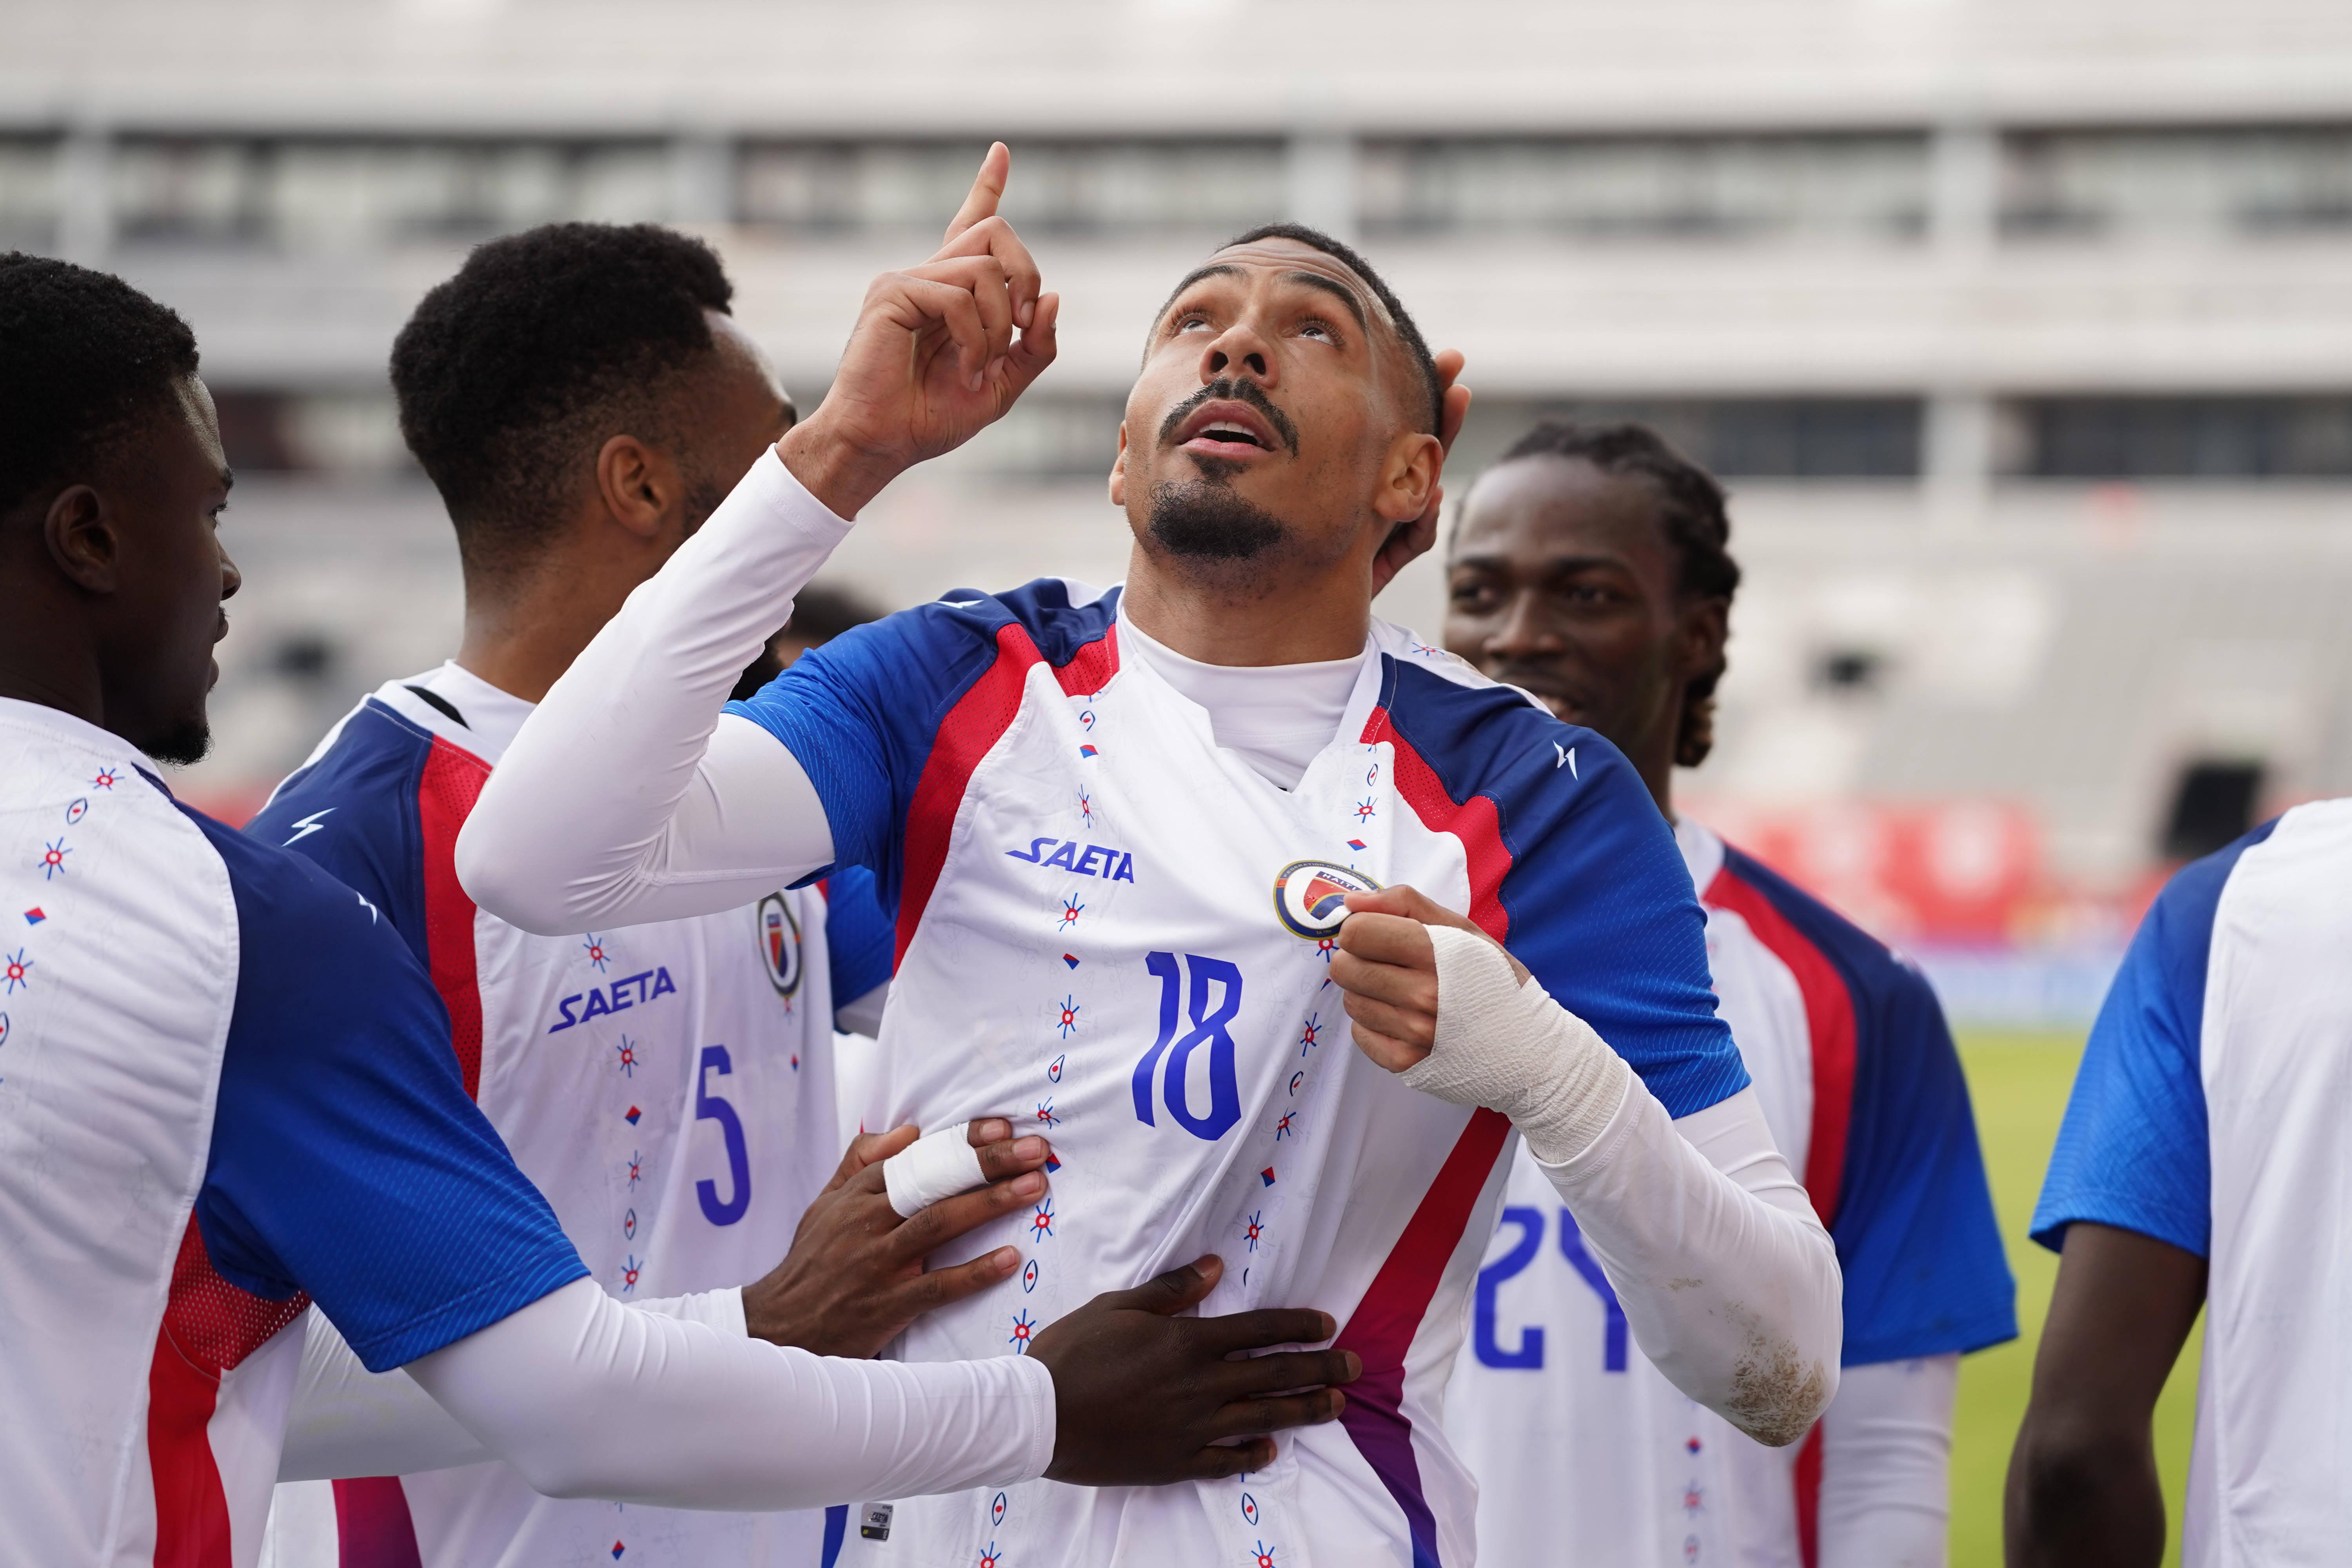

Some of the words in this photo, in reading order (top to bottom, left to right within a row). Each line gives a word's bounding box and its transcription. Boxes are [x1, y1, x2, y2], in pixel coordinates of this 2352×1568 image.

[1004, 837, 1135, 884] SAETA
[1322, 873, 1357, 890] HAITI
[548, 966, 677, 1034] SAETA
[1132, 951, 1243, 1141] 18
[696, 1045, 751, 1226] 5
